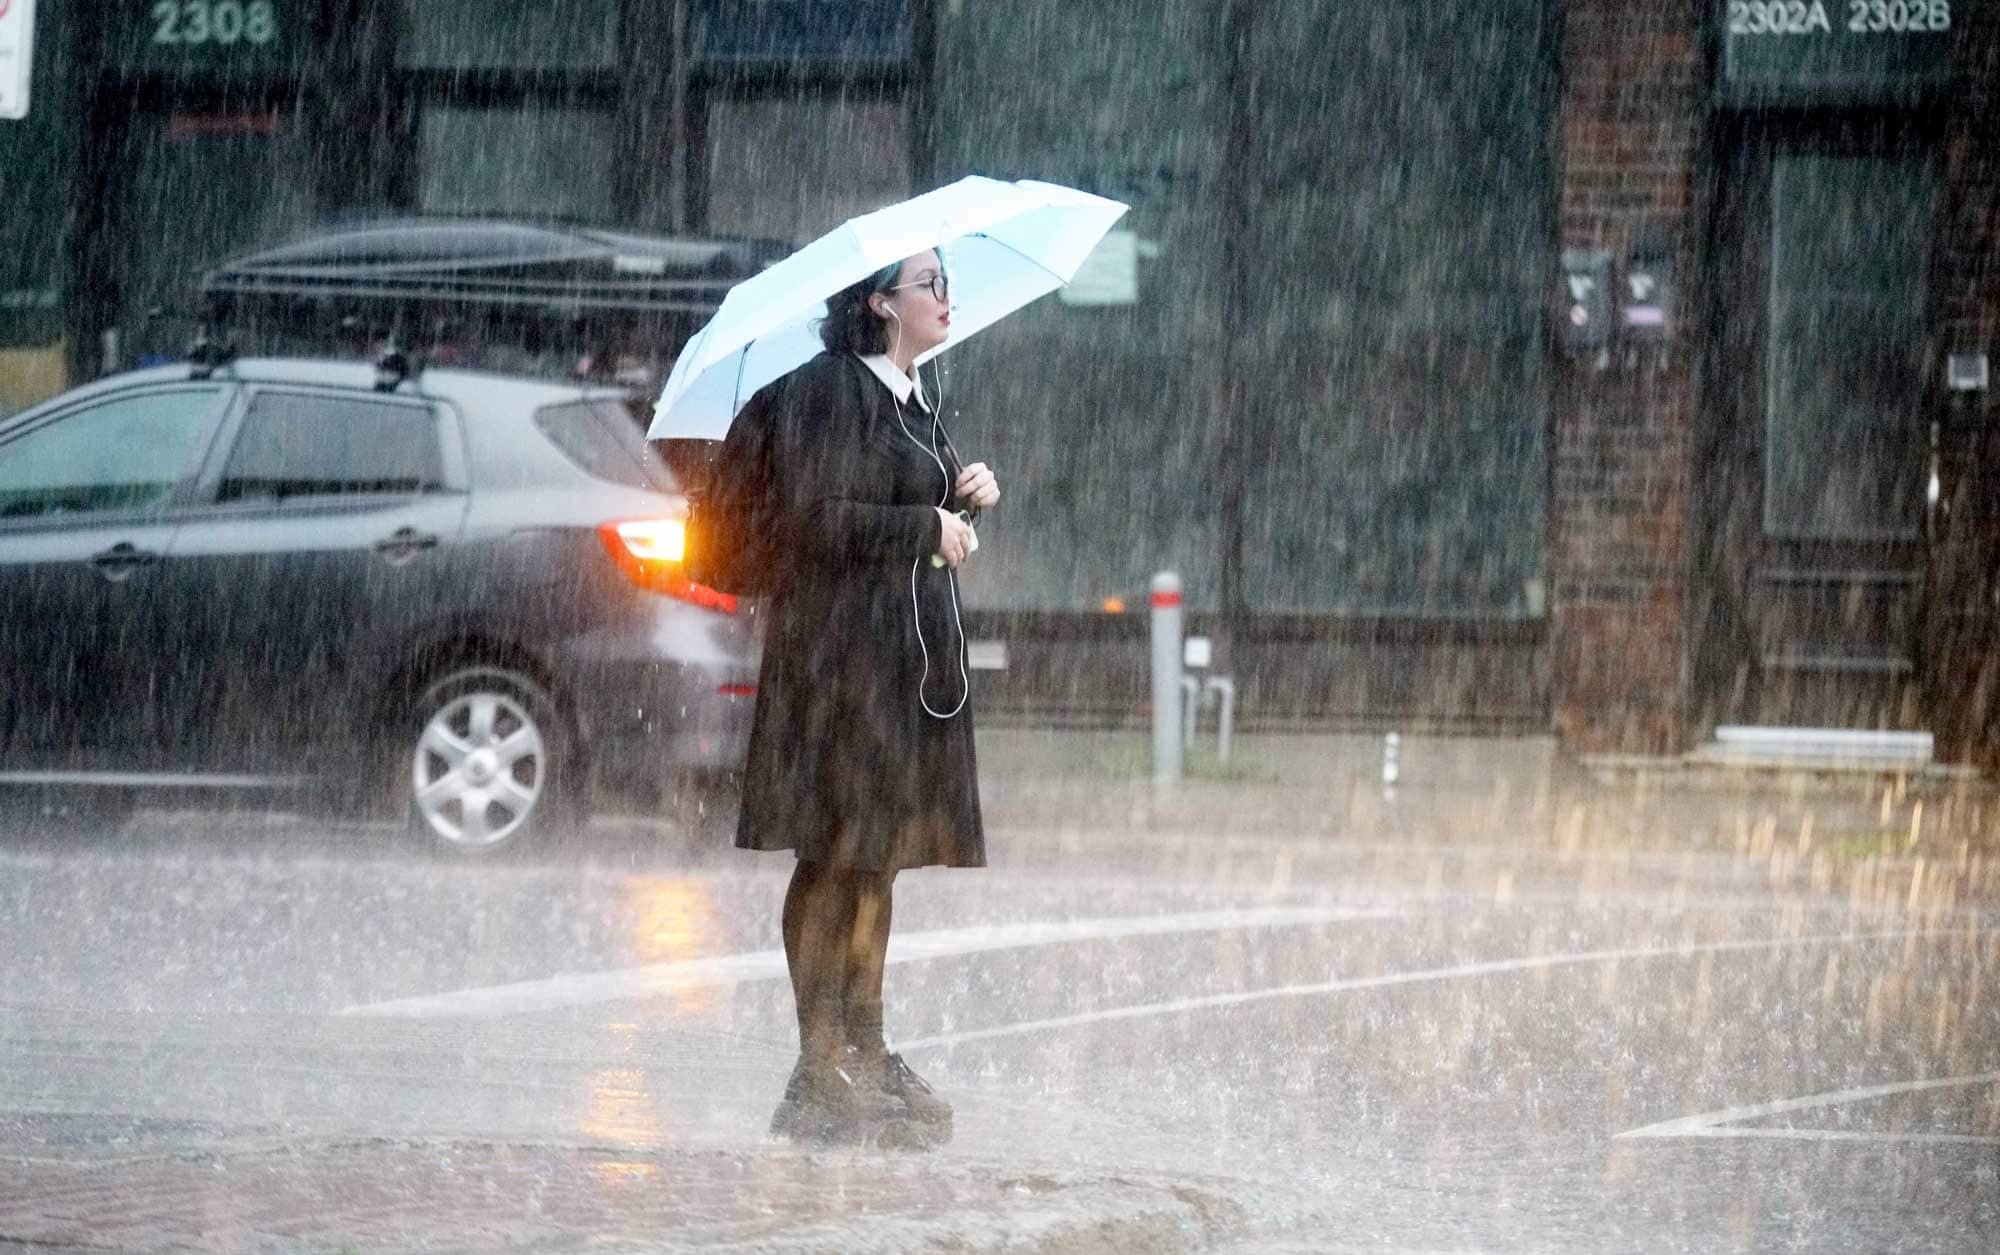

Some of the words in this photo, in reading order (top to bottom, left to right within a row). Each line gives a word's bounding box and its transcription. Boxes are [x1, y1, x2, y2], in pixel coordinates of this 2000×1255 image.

[152, 0, 275, 44] 2308
[1729, 0, 1831, 34] 2302A
[1848, 0, 1951, 32] 2302B
